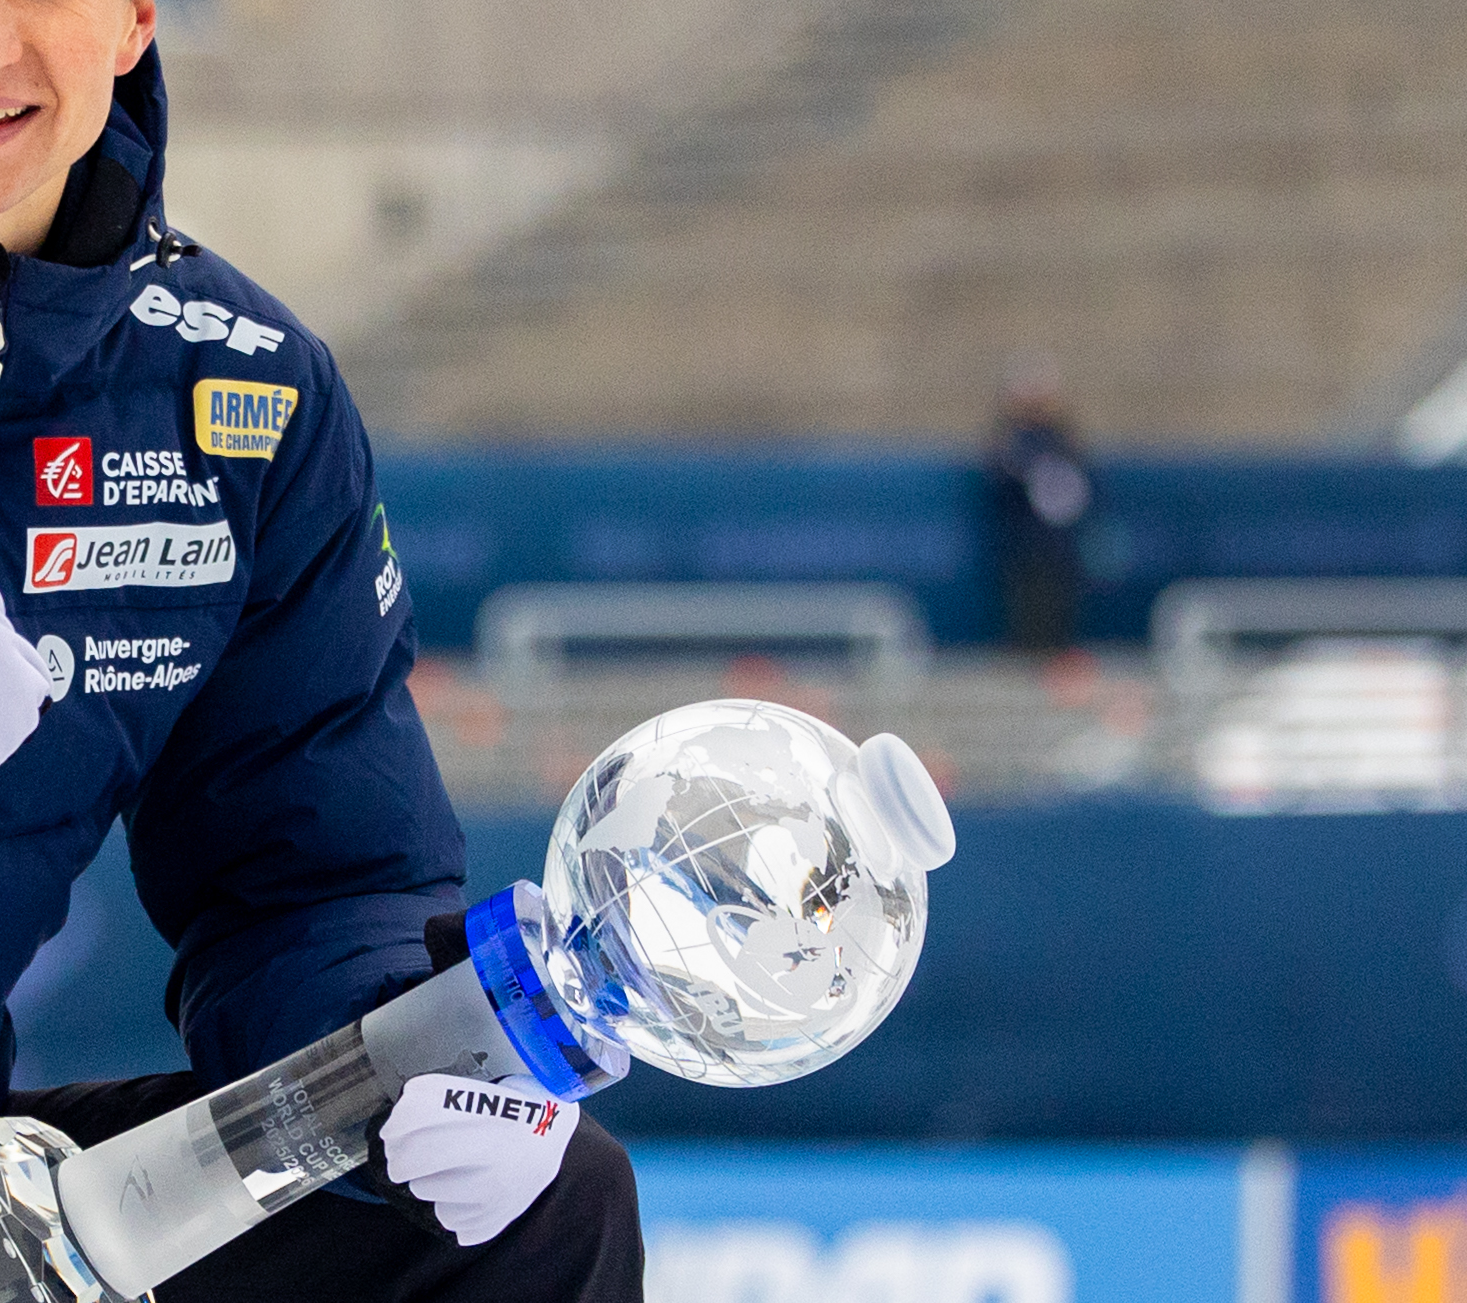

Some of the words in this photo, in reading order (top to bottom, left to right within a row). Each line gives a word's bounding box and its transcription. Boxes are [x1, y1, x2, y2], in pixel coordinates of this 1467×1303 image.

[211, 431, 224, 449] DE
[101, 451, 188, 477] CAISSE
[76, 536, 151, 571] Jean
